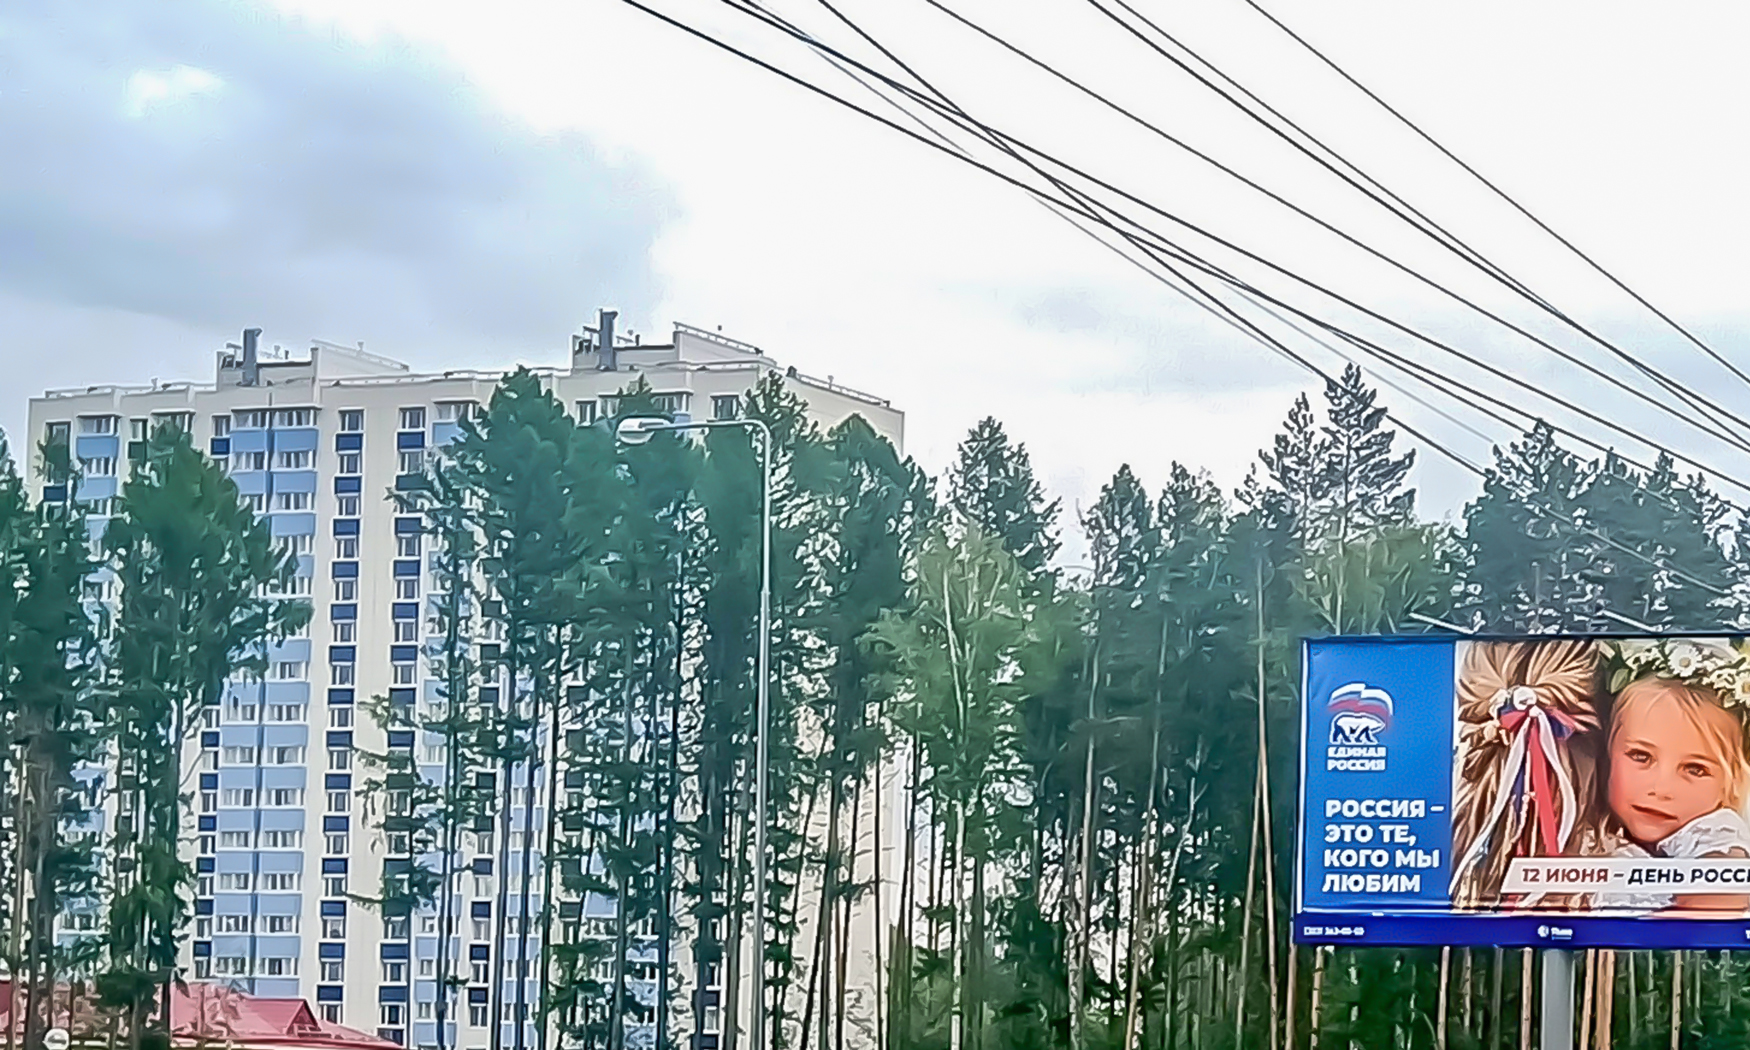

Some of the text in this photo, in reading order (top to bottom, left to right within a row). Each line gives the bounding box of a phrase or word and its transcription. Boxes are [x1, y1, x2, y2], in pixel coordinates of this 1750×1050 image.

[1327, 747, 1386, 757] ЕДИНАЯ
[1327, 759, 1386, 771] РОССИЯ
[1325, 799, 1426, 818] РОССИЯ
[1324, 824, 1417, 847] ЭТО ТЕ,
[1324, 849, 1440, 868] КОГО МЫ
[1322, 874, 1421, 893] ЛЮБИМ
[1522, 868, 1540, 882] 12
[1545, 868, 1609, 883] ИЮНЯ
[1627, 868, 1685, 885] ДЕНЬ
